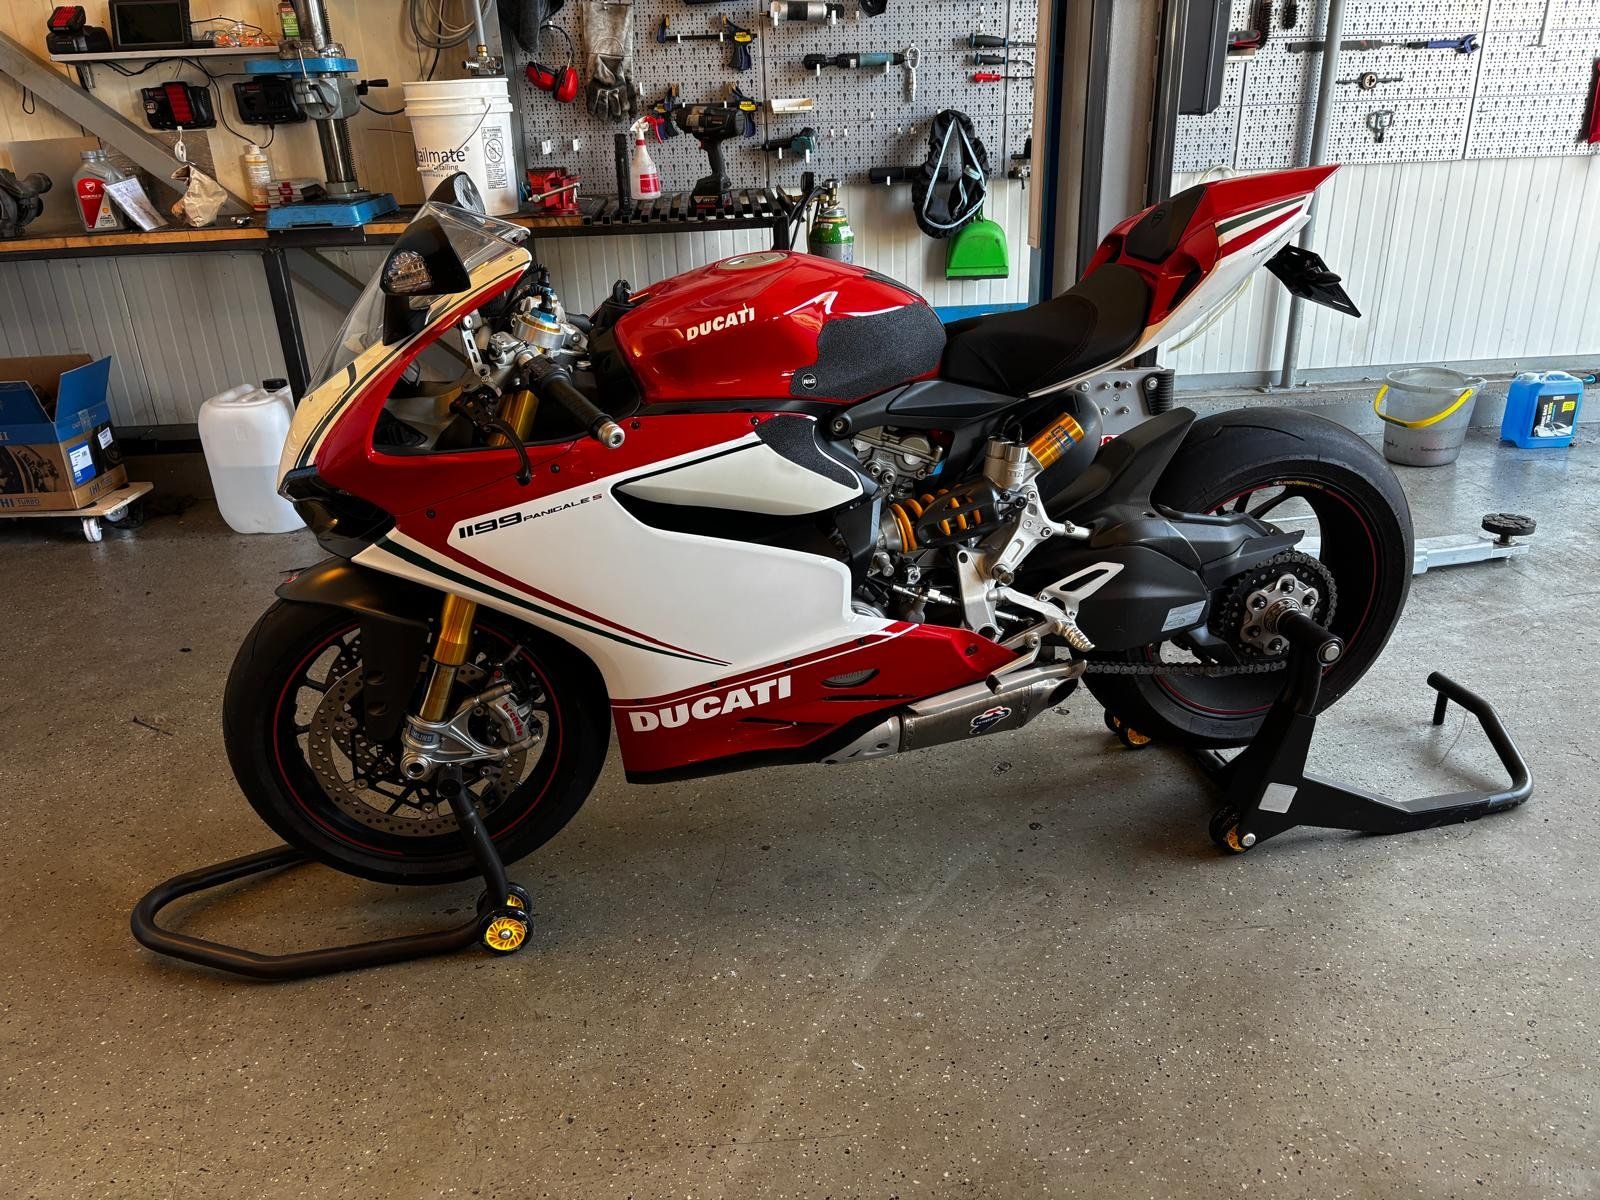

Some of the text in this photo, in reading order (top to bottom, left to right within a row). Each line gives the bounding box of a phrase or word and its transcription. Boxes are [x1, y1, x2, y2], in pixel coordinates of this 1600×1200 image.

[686, 307, 755, 341] DUCATI
[459, 493, 603, 539] 1199 PANIGALE S
[502, 702, 523, 737] brembo
[628, 675, 791, 732] DUCATI
